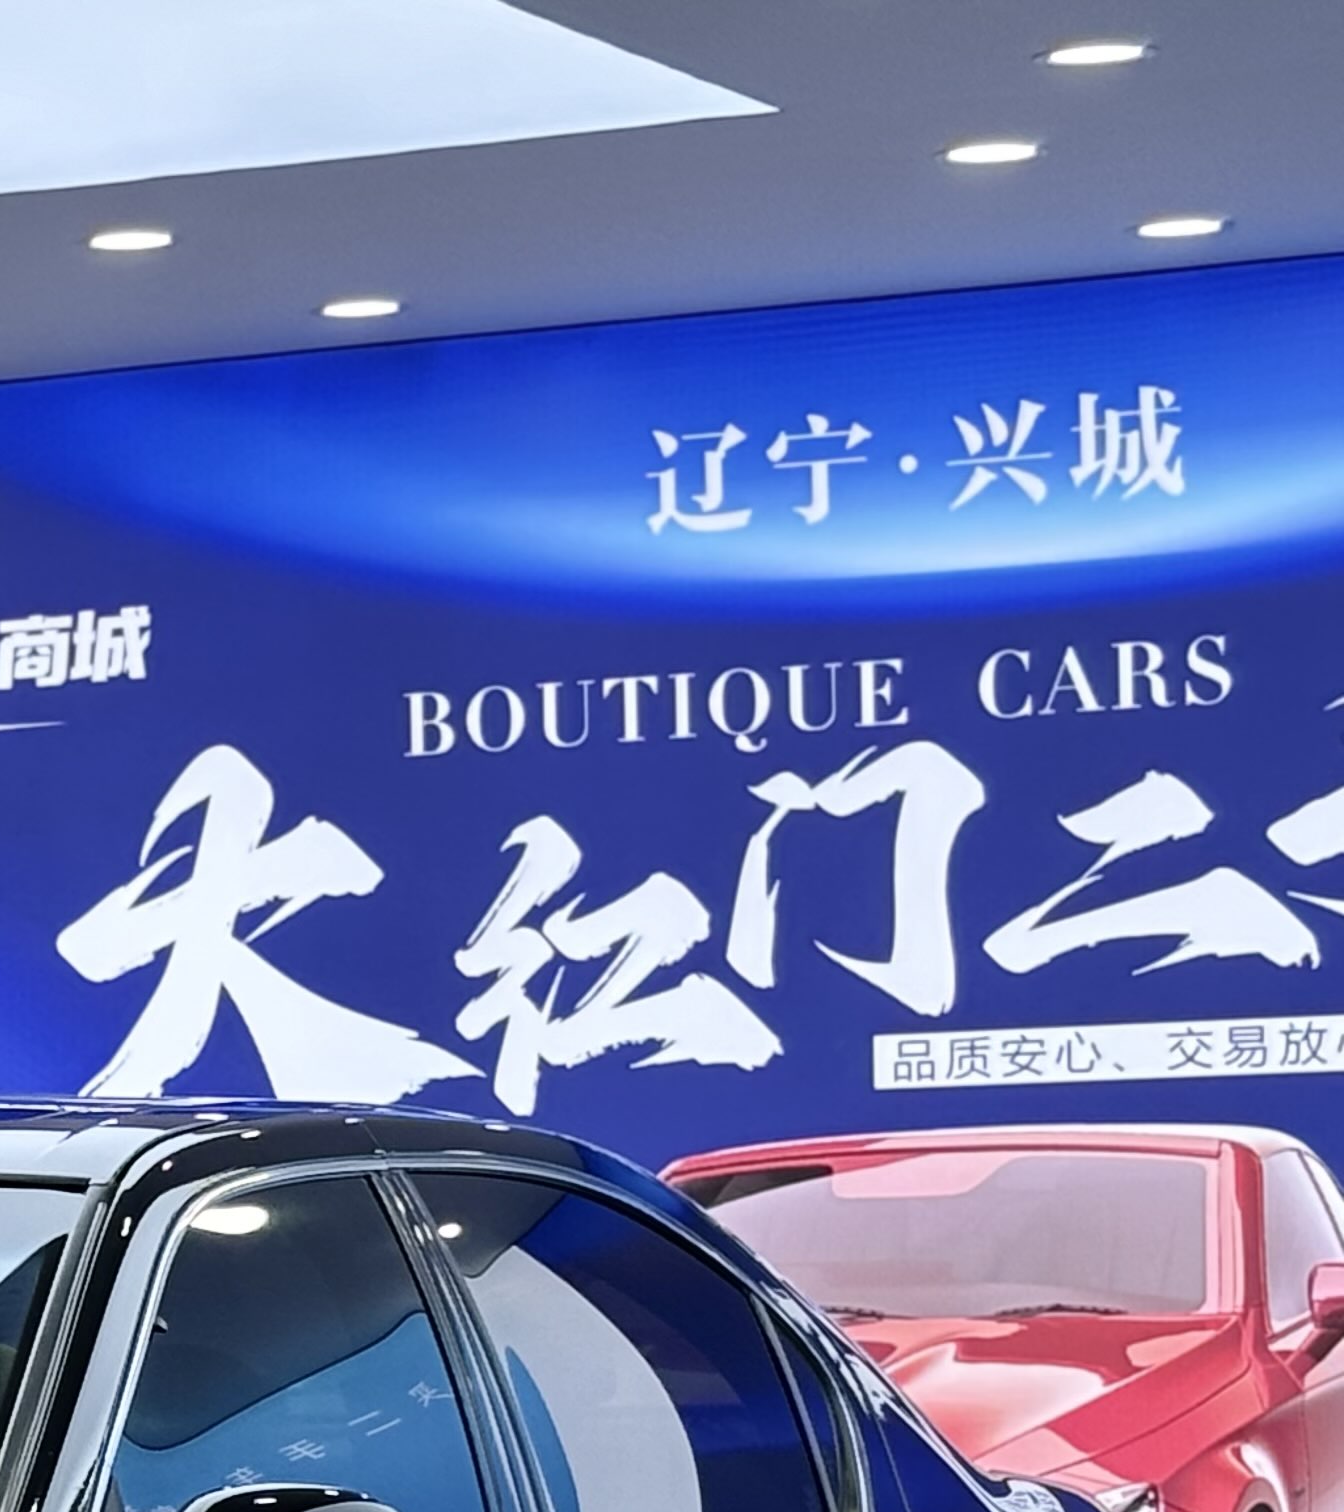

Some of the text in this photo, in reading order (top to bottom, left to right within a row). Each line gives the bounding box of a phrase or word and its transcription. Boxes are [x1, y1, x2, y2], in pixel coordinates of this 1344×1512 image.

[647, 386, 1186, 535] 辽宁·兴城
[405, 636, 1234, 753] BOUTIQUE CARS
[57, 740, 1344, 1117] 大红门二
[893, 1021, 1344, 1082] 品质安心、交易放
